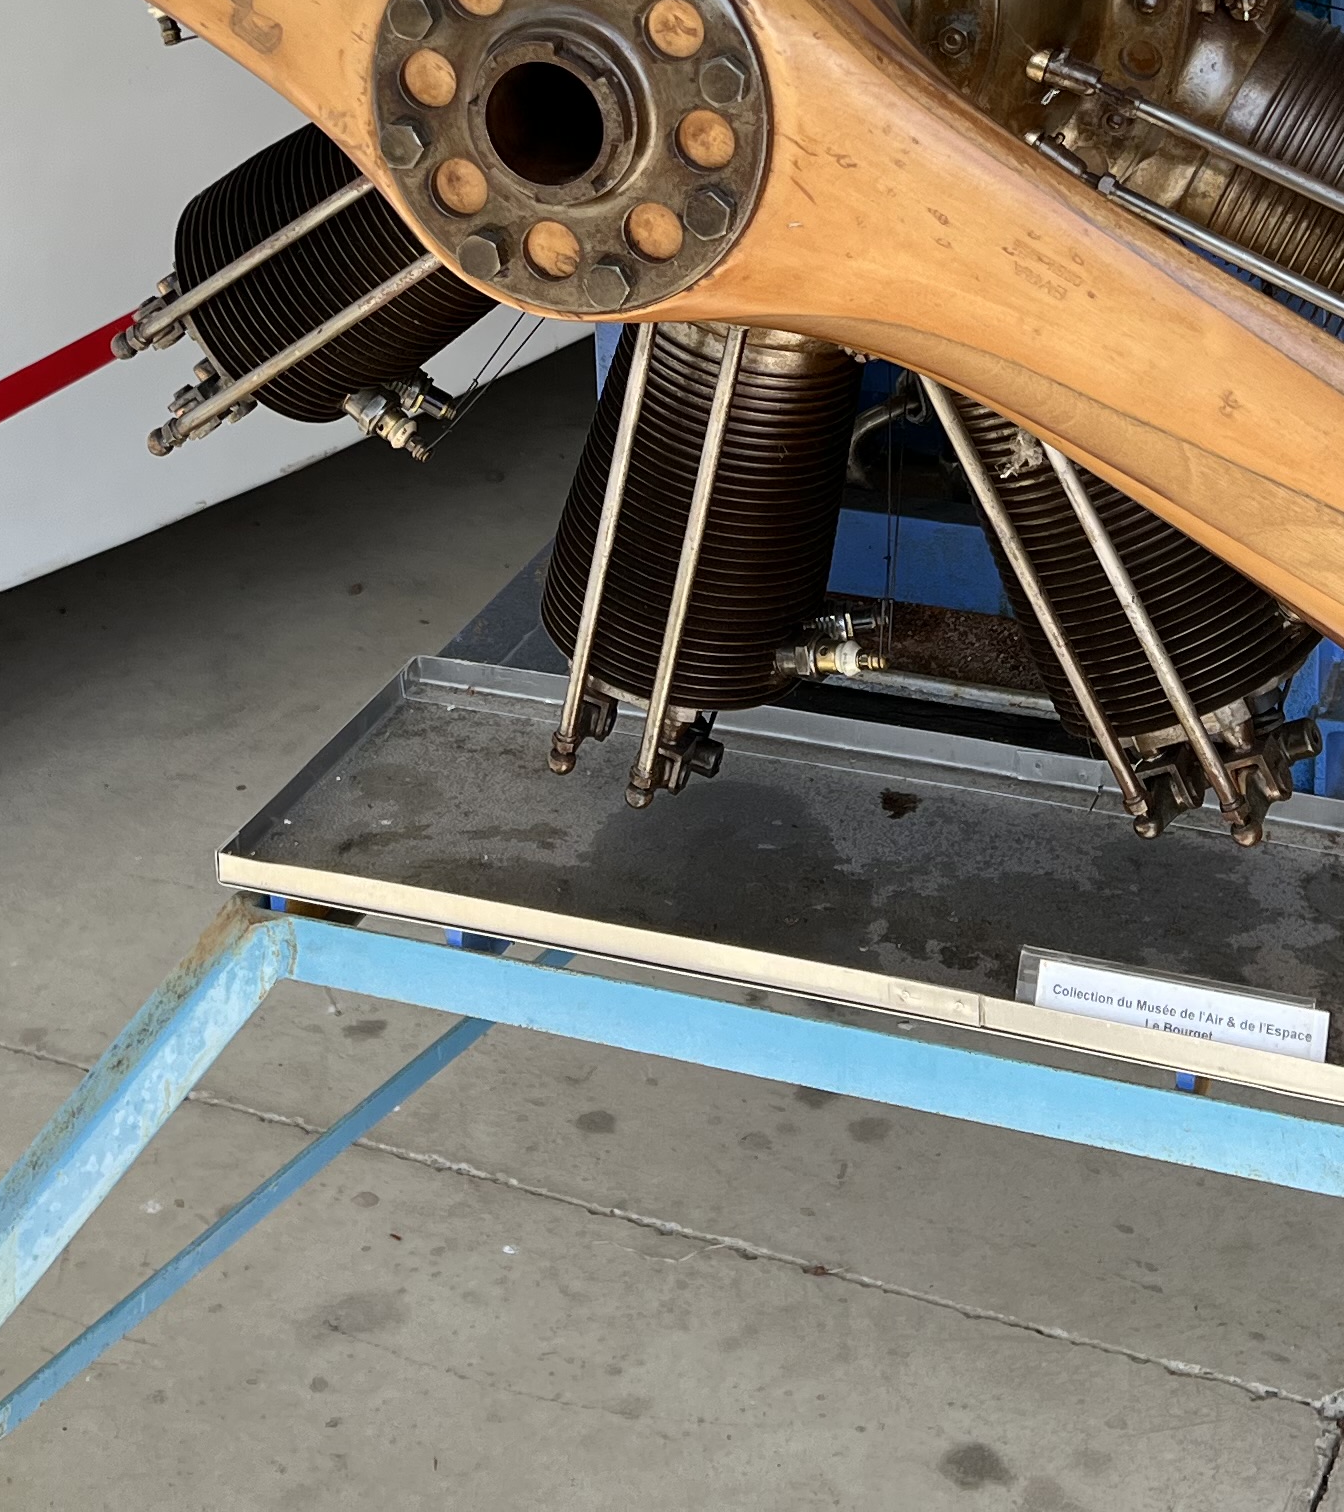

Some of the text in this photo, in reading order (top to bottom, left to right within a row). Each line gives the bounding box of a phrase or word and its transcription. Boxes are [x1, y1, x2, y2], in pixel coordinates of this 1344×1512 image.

[1052, 983, 1313, 1043] Collection du Musée de l'Air & de l'Espace
